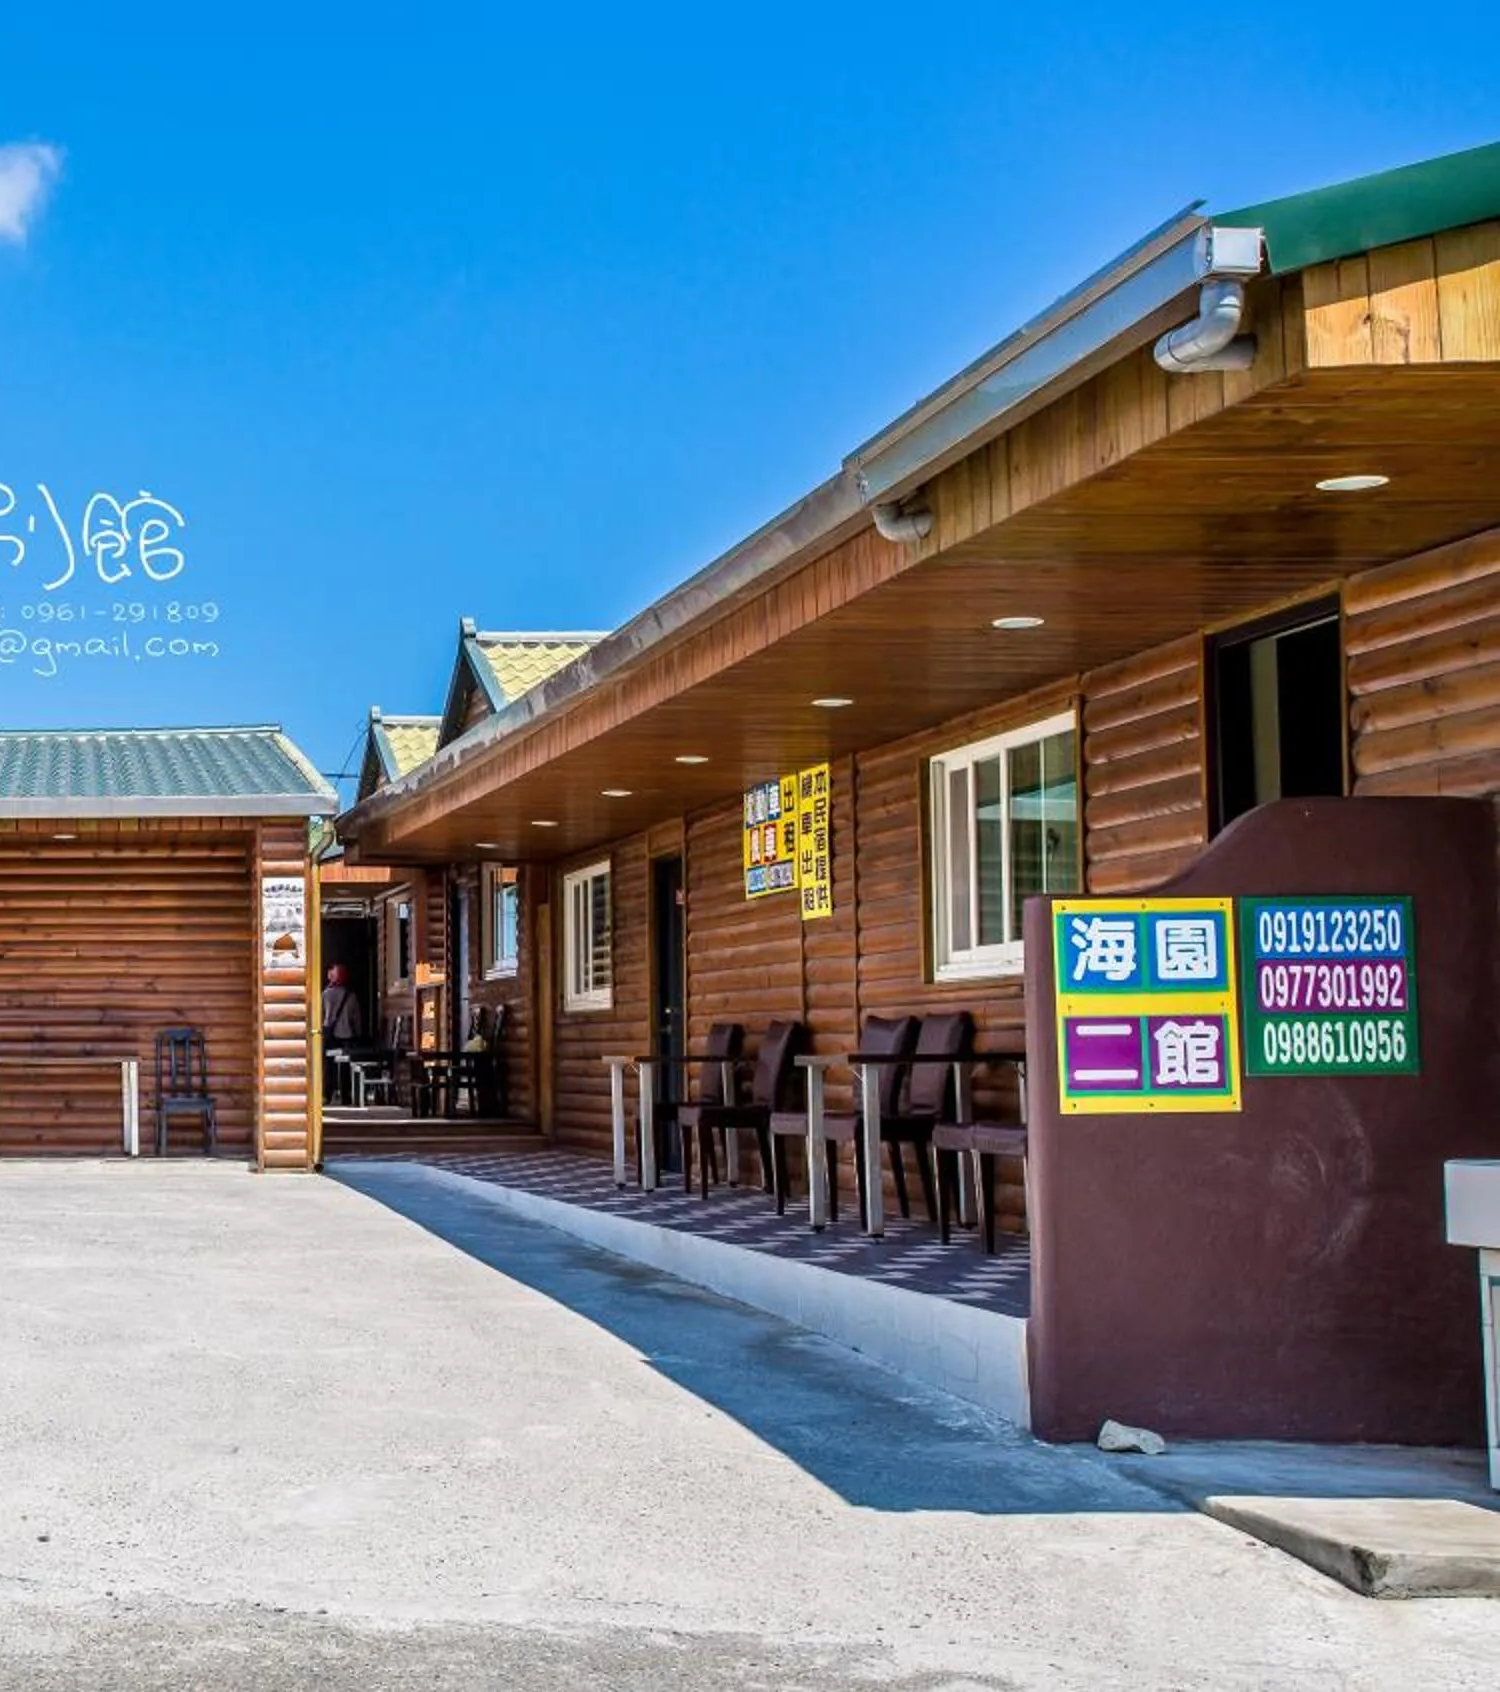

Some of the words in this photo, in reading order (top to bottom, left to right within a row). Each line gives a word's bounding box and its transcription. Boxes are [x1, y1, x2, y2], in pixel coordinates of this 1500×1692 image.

[1071, 917, 1218, 981] 海園
[1259, 909, 1401, 953] 0919123250
[1261, 964, 1404, 1008] 0977301992
[1073, 1020, 1220, 1085] 二館
[1263, 1019, 1408, 1065] 0988610956
